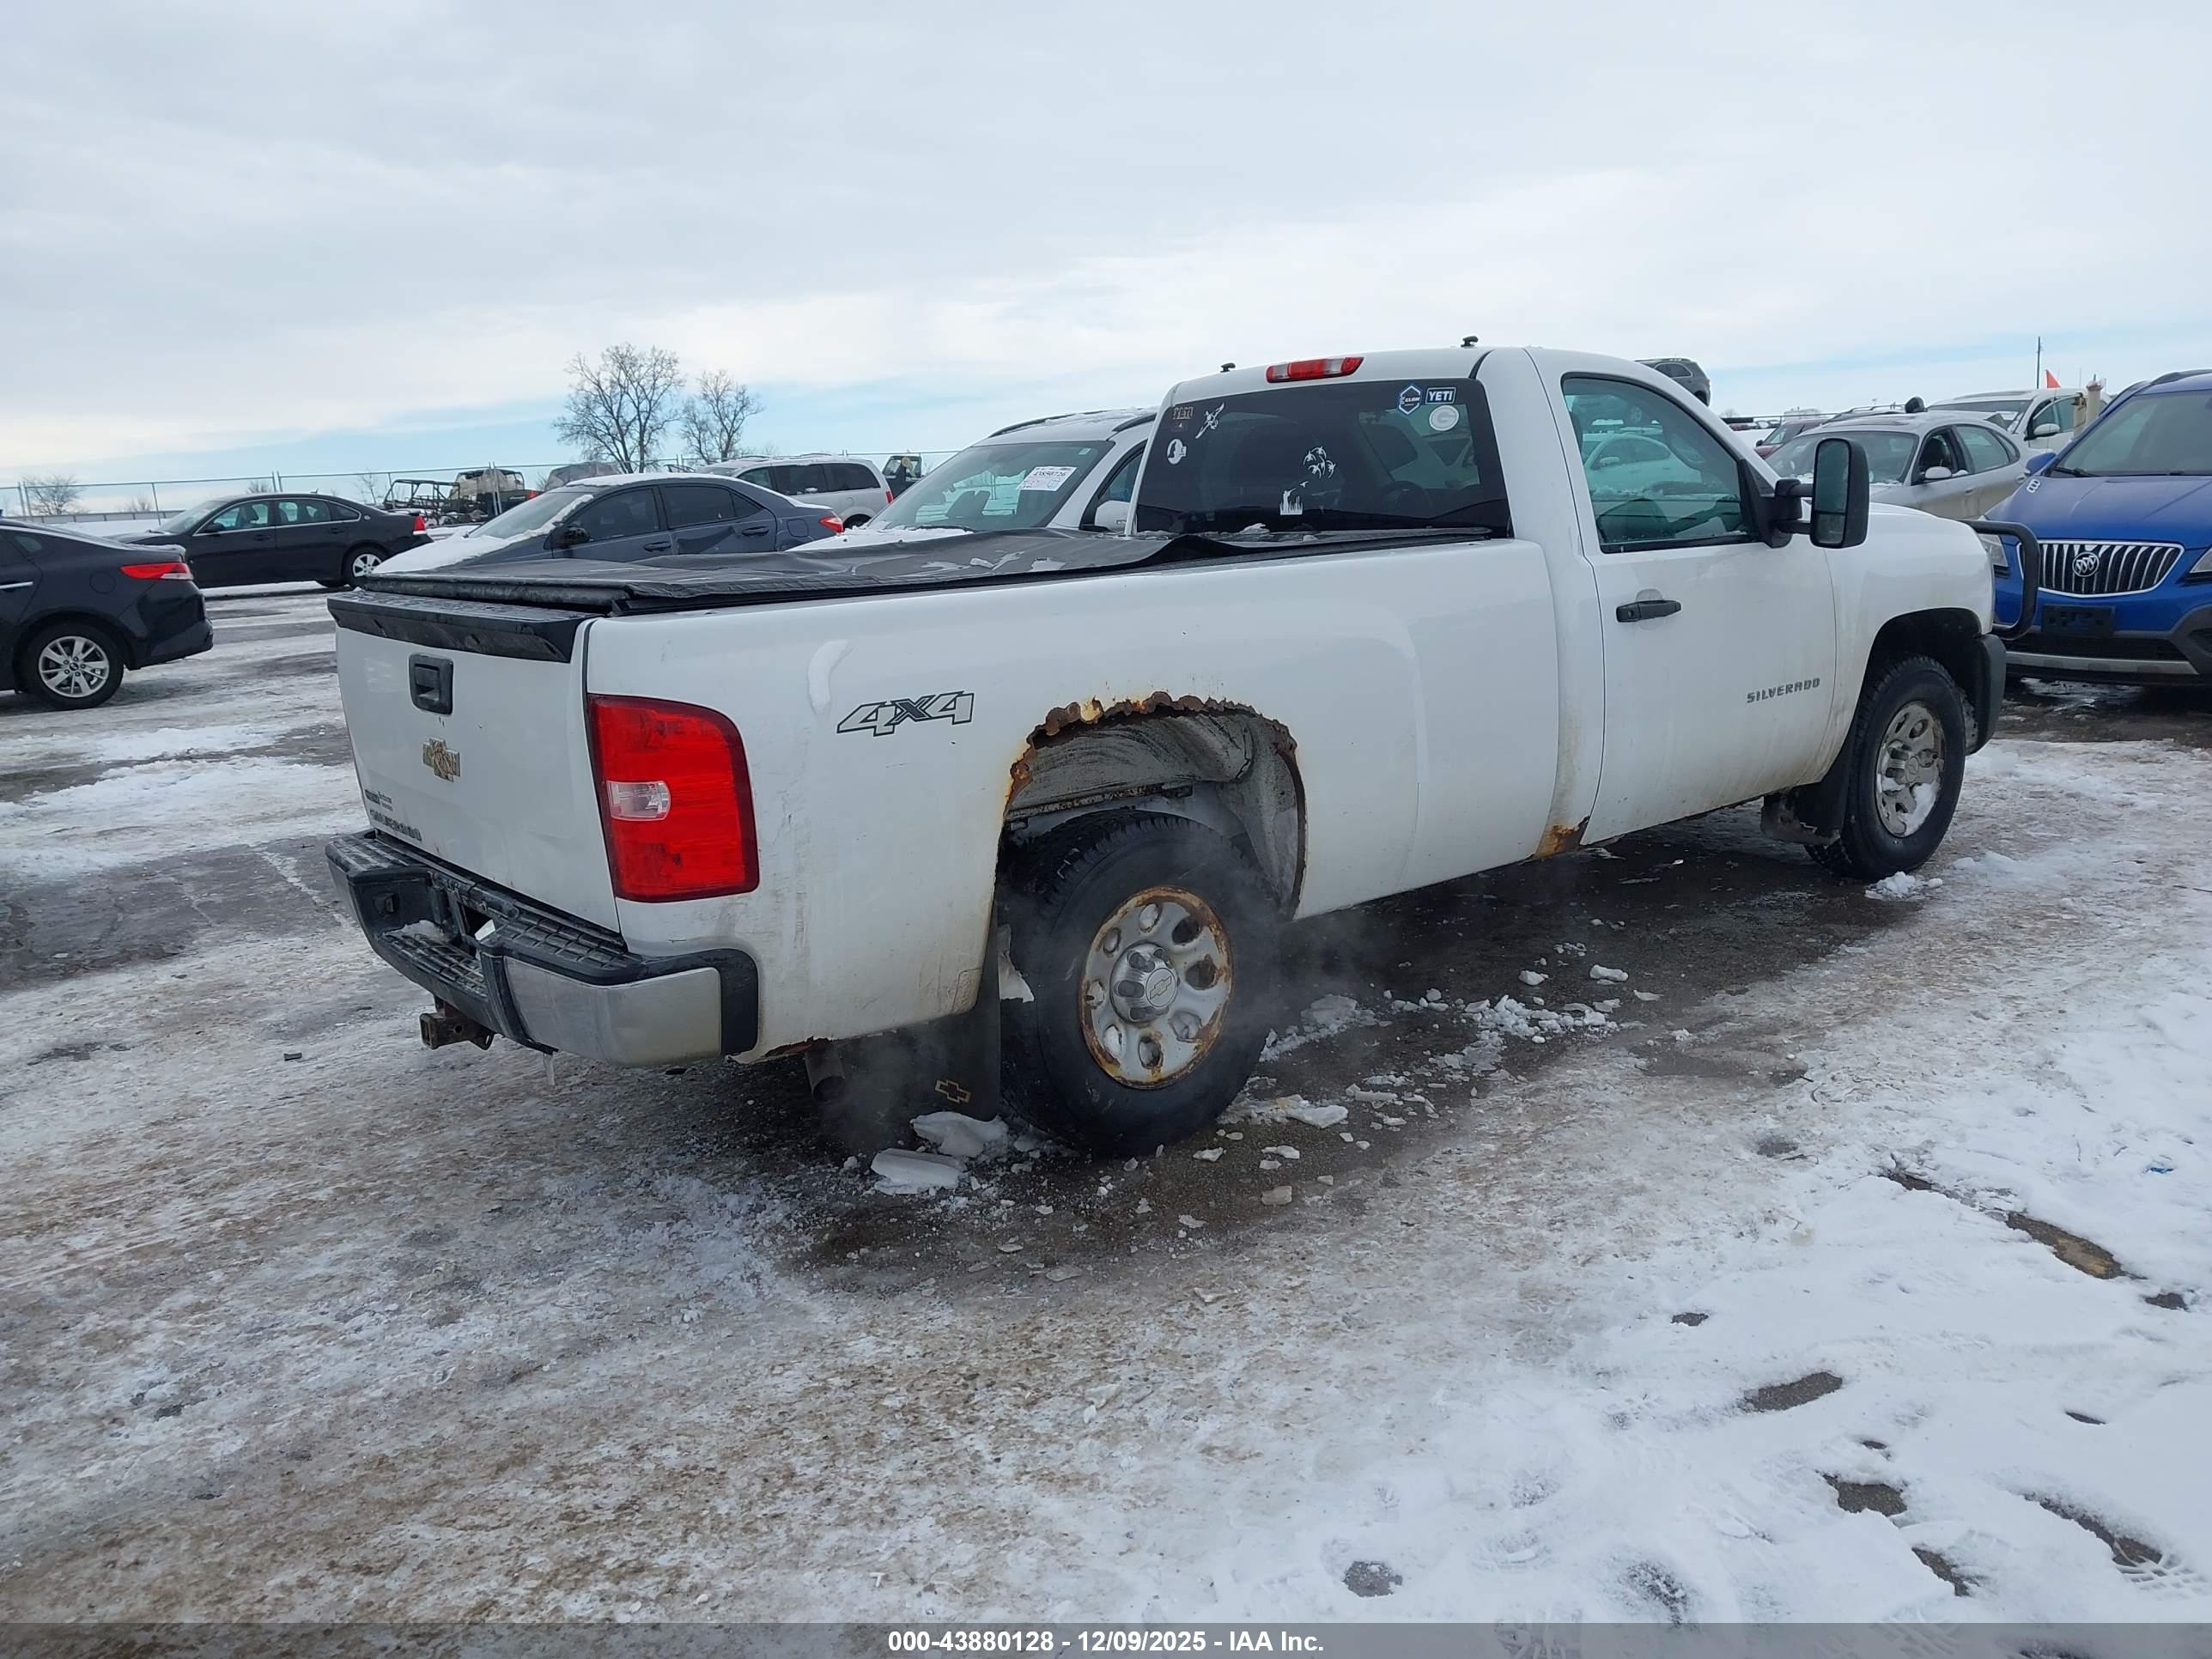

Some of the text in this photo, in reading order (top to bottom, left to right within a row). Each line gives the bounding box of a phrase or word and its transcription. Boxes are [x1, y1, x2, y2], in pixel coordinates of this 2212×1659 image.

[1428, 391, 1454, 402] YETI
[1747, 677, 1820, 703] SILVERADO
[369, 809, 422, 842] SERADO
